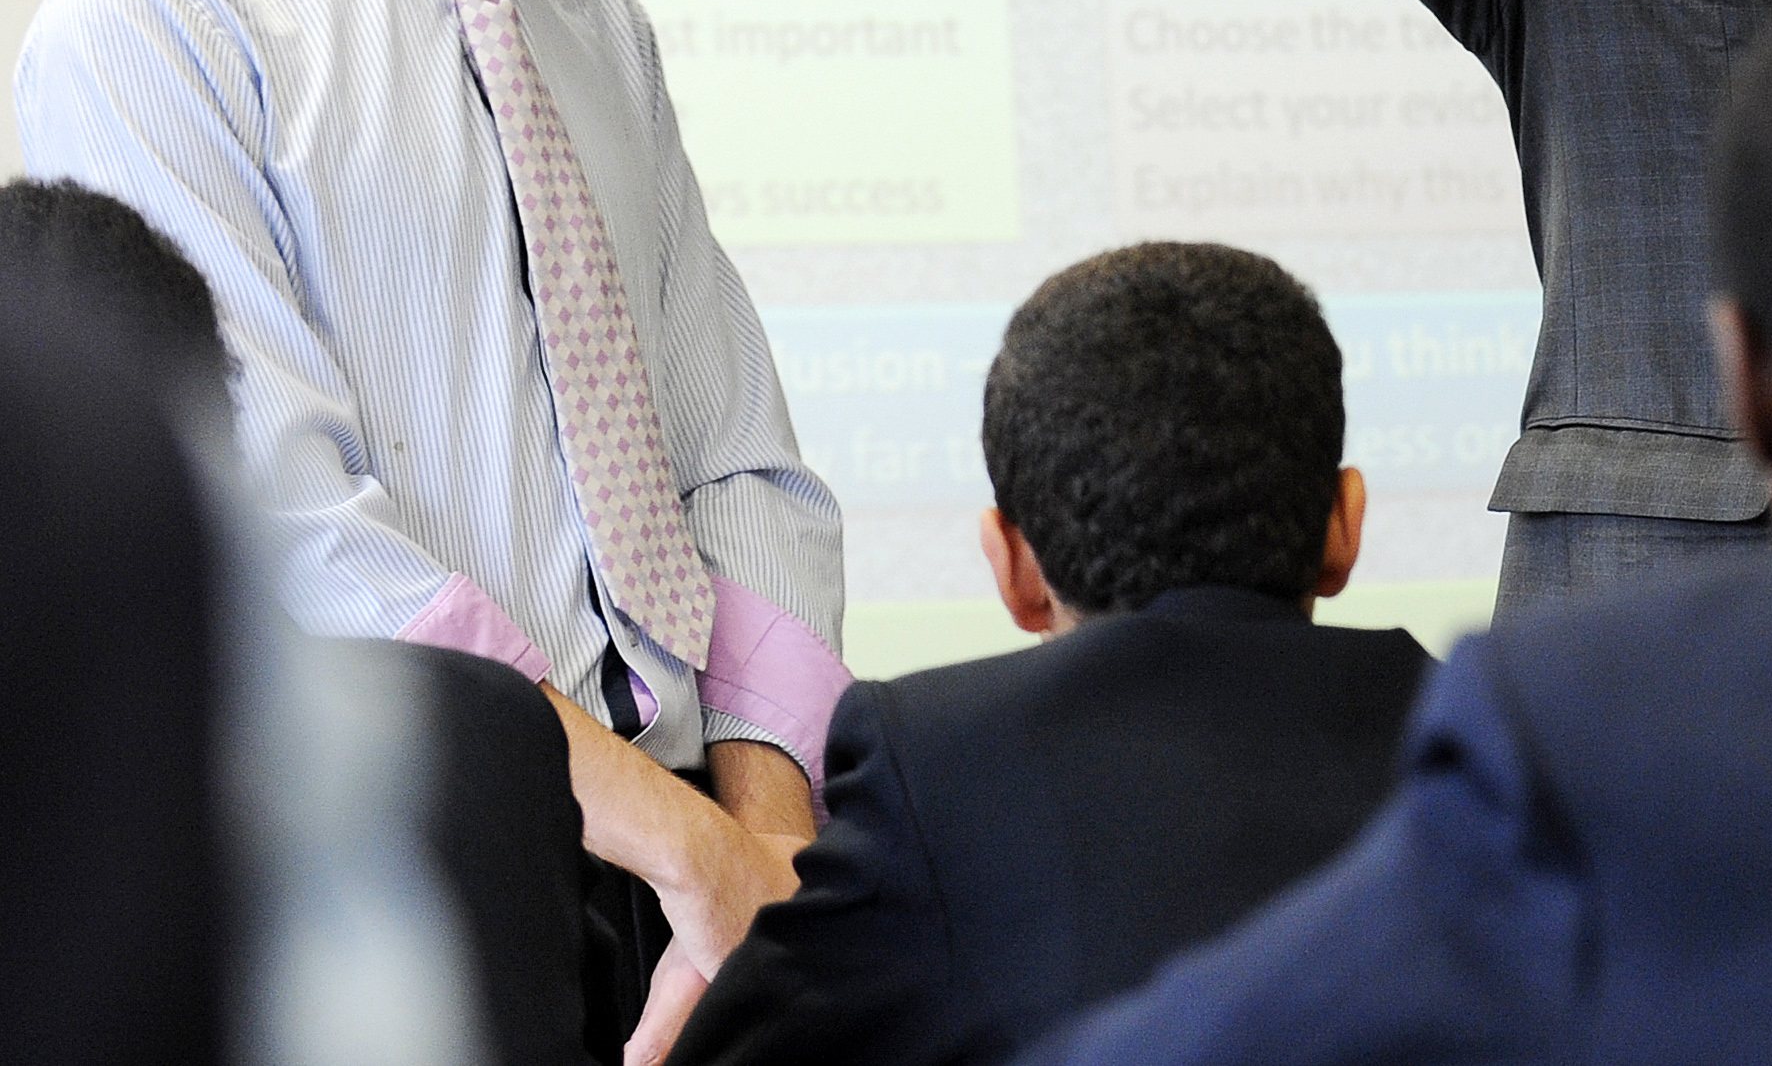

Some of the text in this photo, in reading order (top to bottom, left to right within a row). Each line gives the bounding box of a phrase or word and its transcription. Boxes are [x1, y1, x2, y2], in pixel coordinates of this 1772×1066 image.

[711, 8, 962, 68] important
[1122, 6, 1298, 57] Choose
[1309, 5, 1390, 54] the
[1127, 83, 1271, 133] Select
[1281, 89, 1391, 141] your
[760, 177, 949, 218] success
[1132, 158, 1510, 218] Explain why this
[850, 424, 930, 485] far
